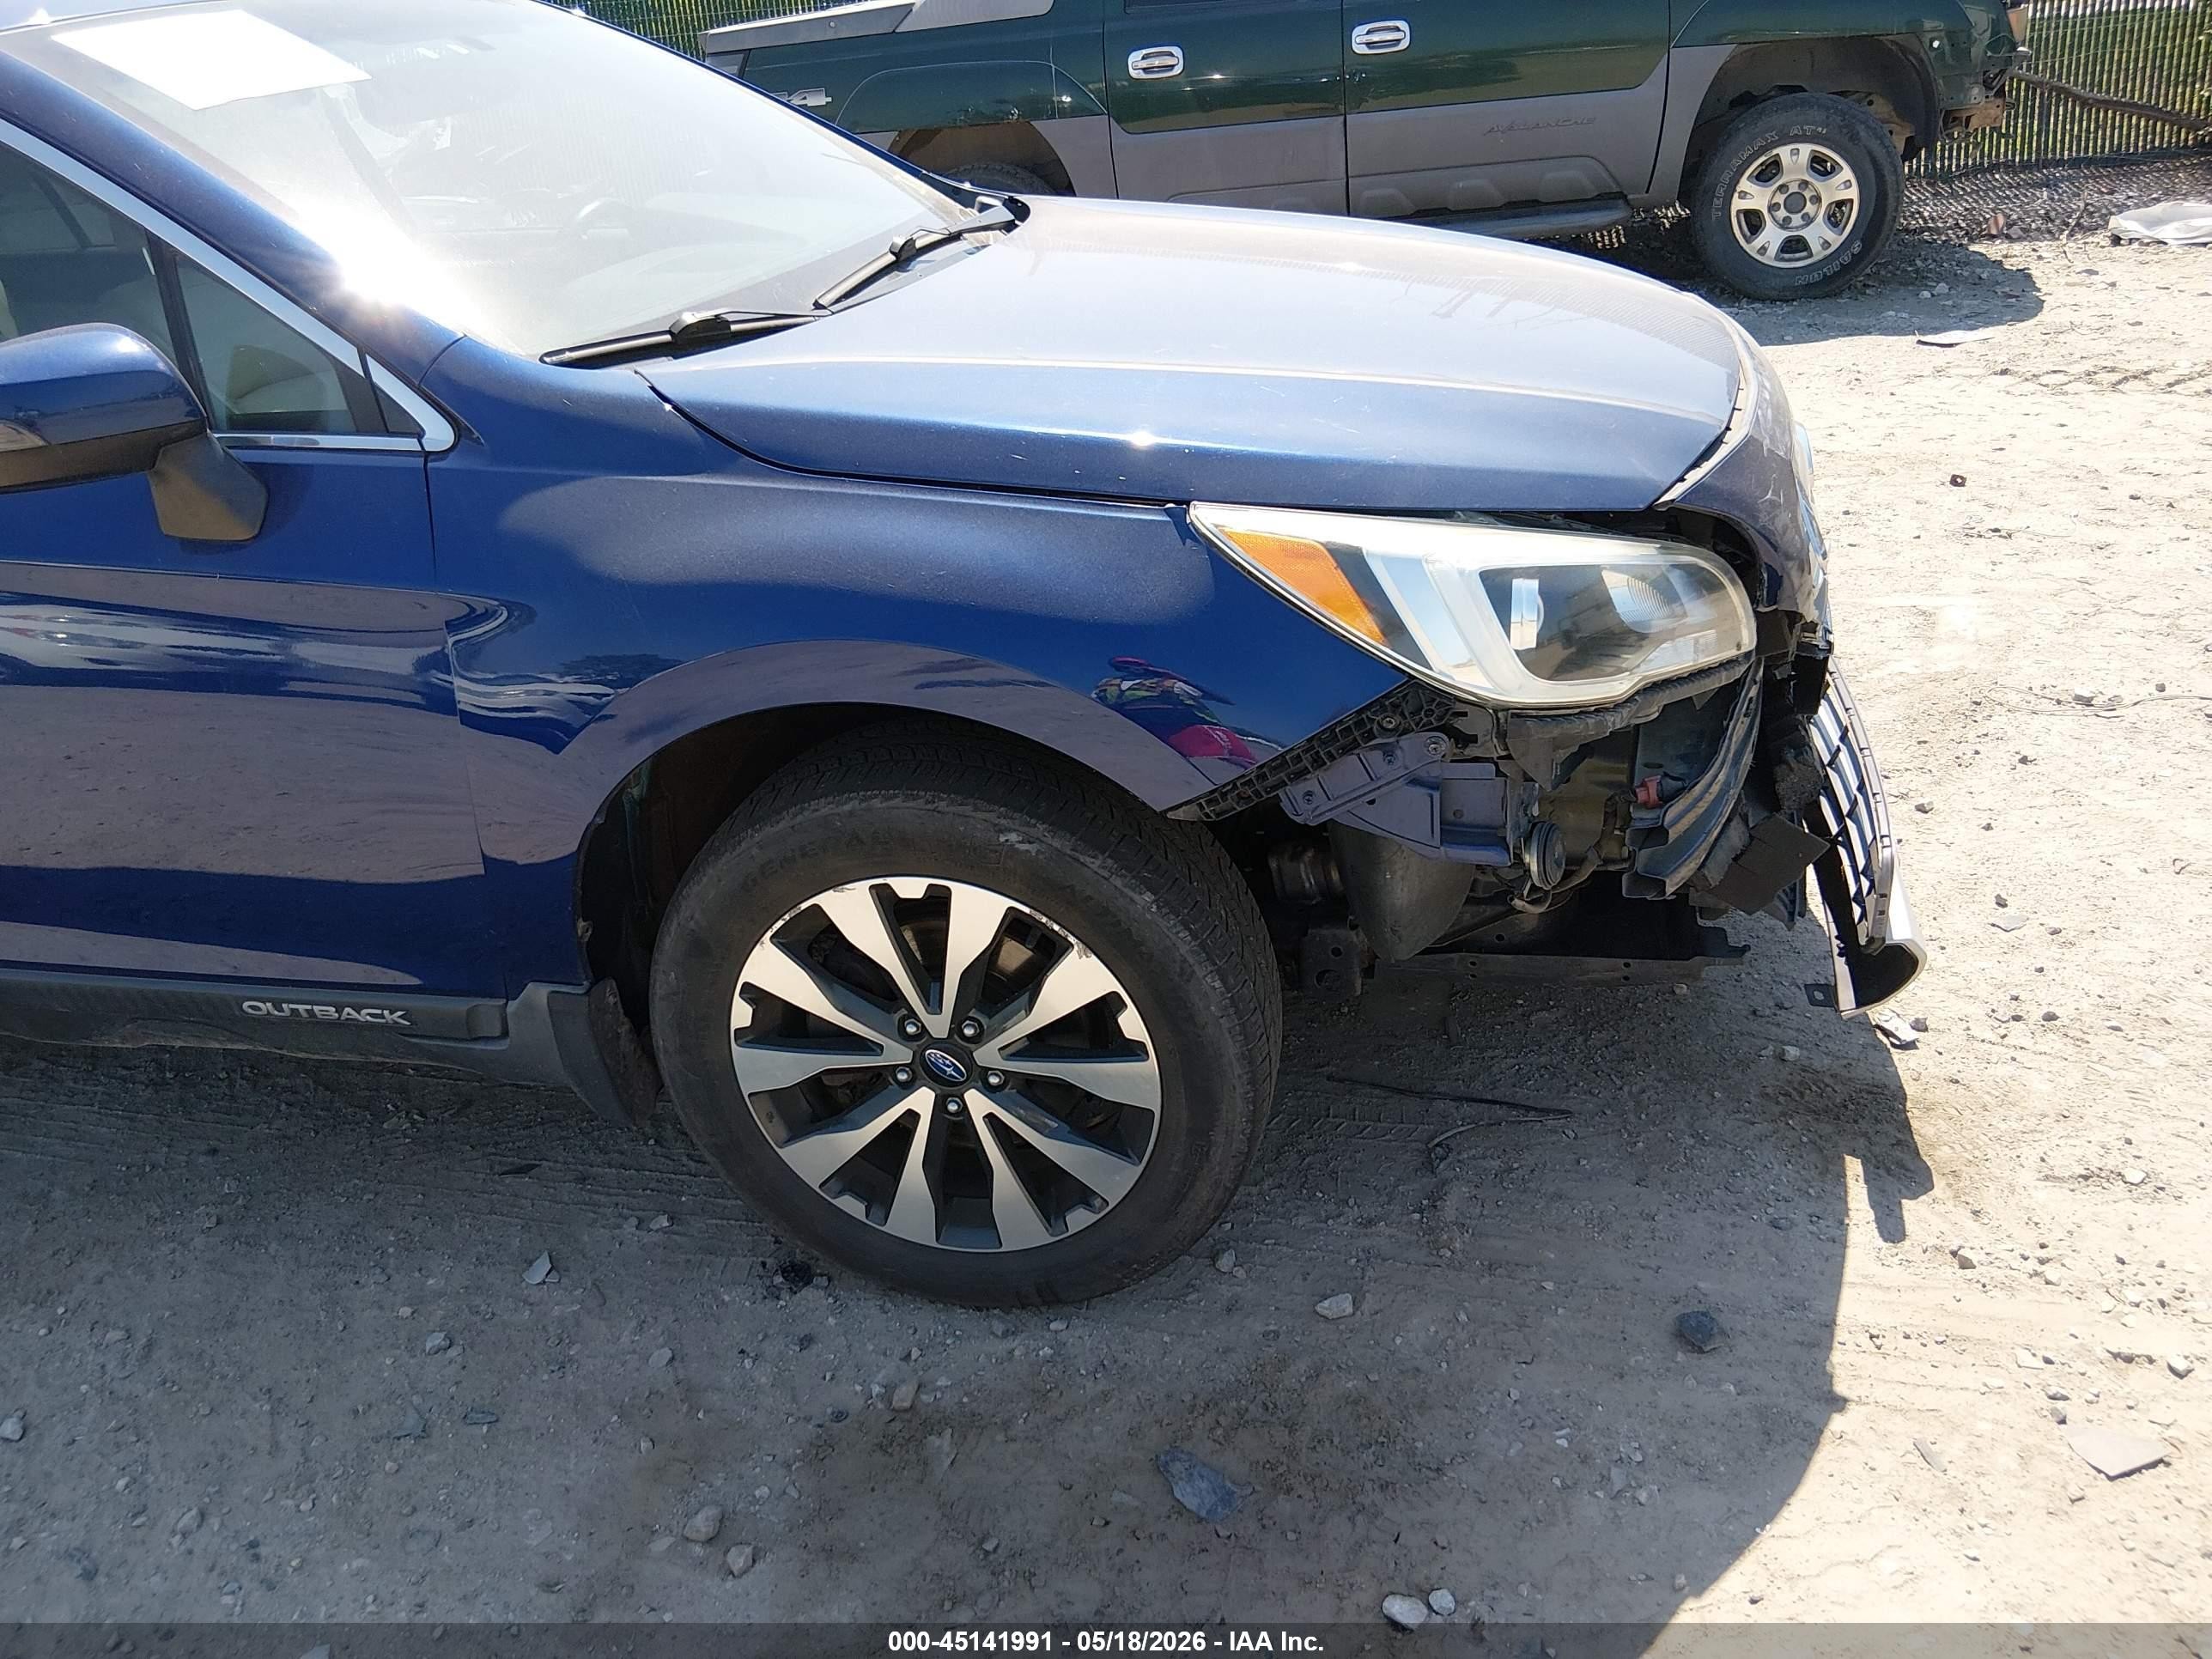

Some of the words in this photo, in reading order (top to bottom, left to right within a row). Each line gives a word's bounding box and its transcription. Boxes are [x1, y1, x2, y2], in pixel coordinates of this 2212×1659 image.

[1483, 117, 1596, 137] AVALANCHE
[1711, 129, 1779, 221] TERRAMAX
[1795, 240, 1863, 285] SAILUN
[241, 1000, 413, 1025] OUTBACK
